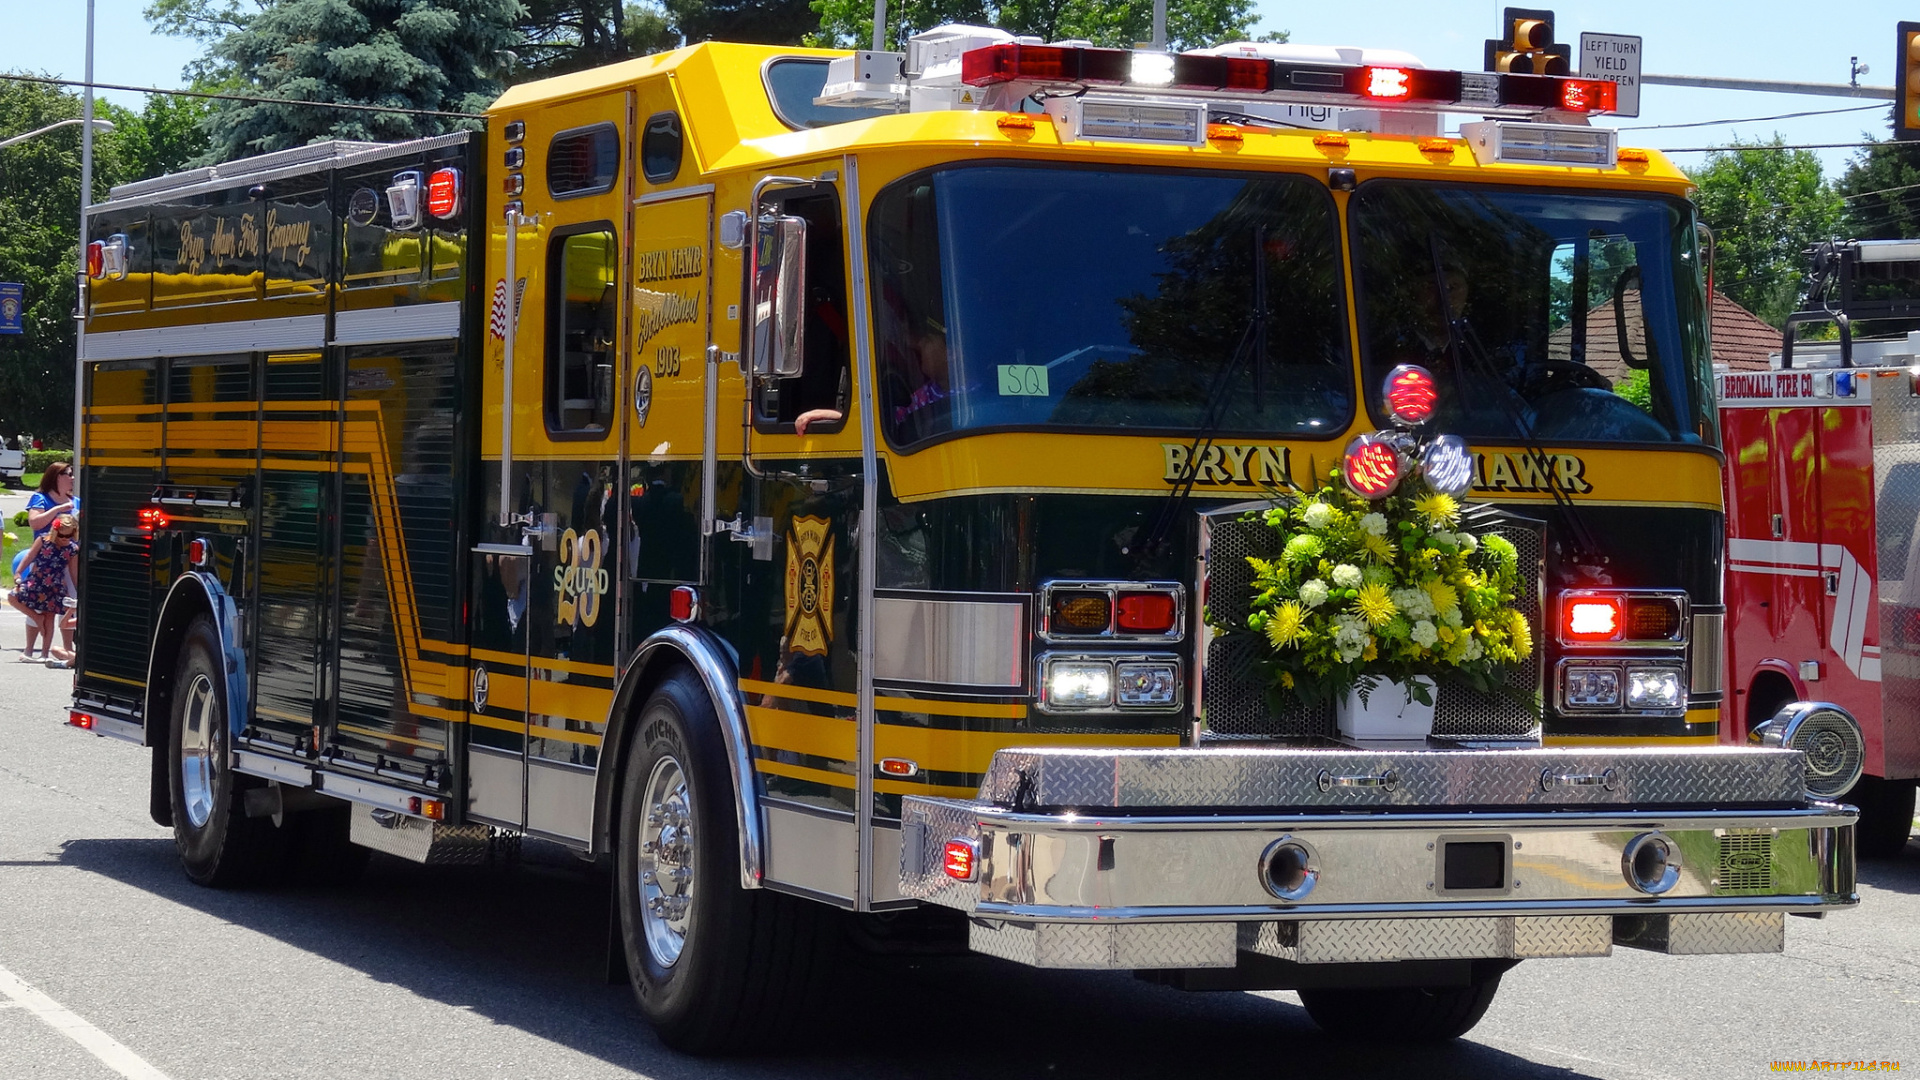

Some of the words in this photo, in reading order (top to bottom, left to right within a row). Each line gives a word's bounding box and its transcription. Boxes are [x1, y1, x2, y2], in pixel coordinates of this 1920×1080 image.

[1586, 40, 1608, 52] LEFT
[1612, 42, 1637, 54] TURN
[1594, 56, 1627, 71] YIELD
[266, 207, 311, 267] Company
[639, 250, 667, 283] BRYN
[669, 245, 702, 280] MAWR
[637, 289, 700, 354] Established
[654, 345, 680, 378] 1903
[1007, 365, 1044, 395] SQ
[1724, 375, 1774, 398] BROOMALL
[1776, 373, 1798, 398] FIRE
[1161, 443, 1292, 487] BRYN
[553, 565, 609, 597] SQUAD
[558, 527, 602, 628] 23
